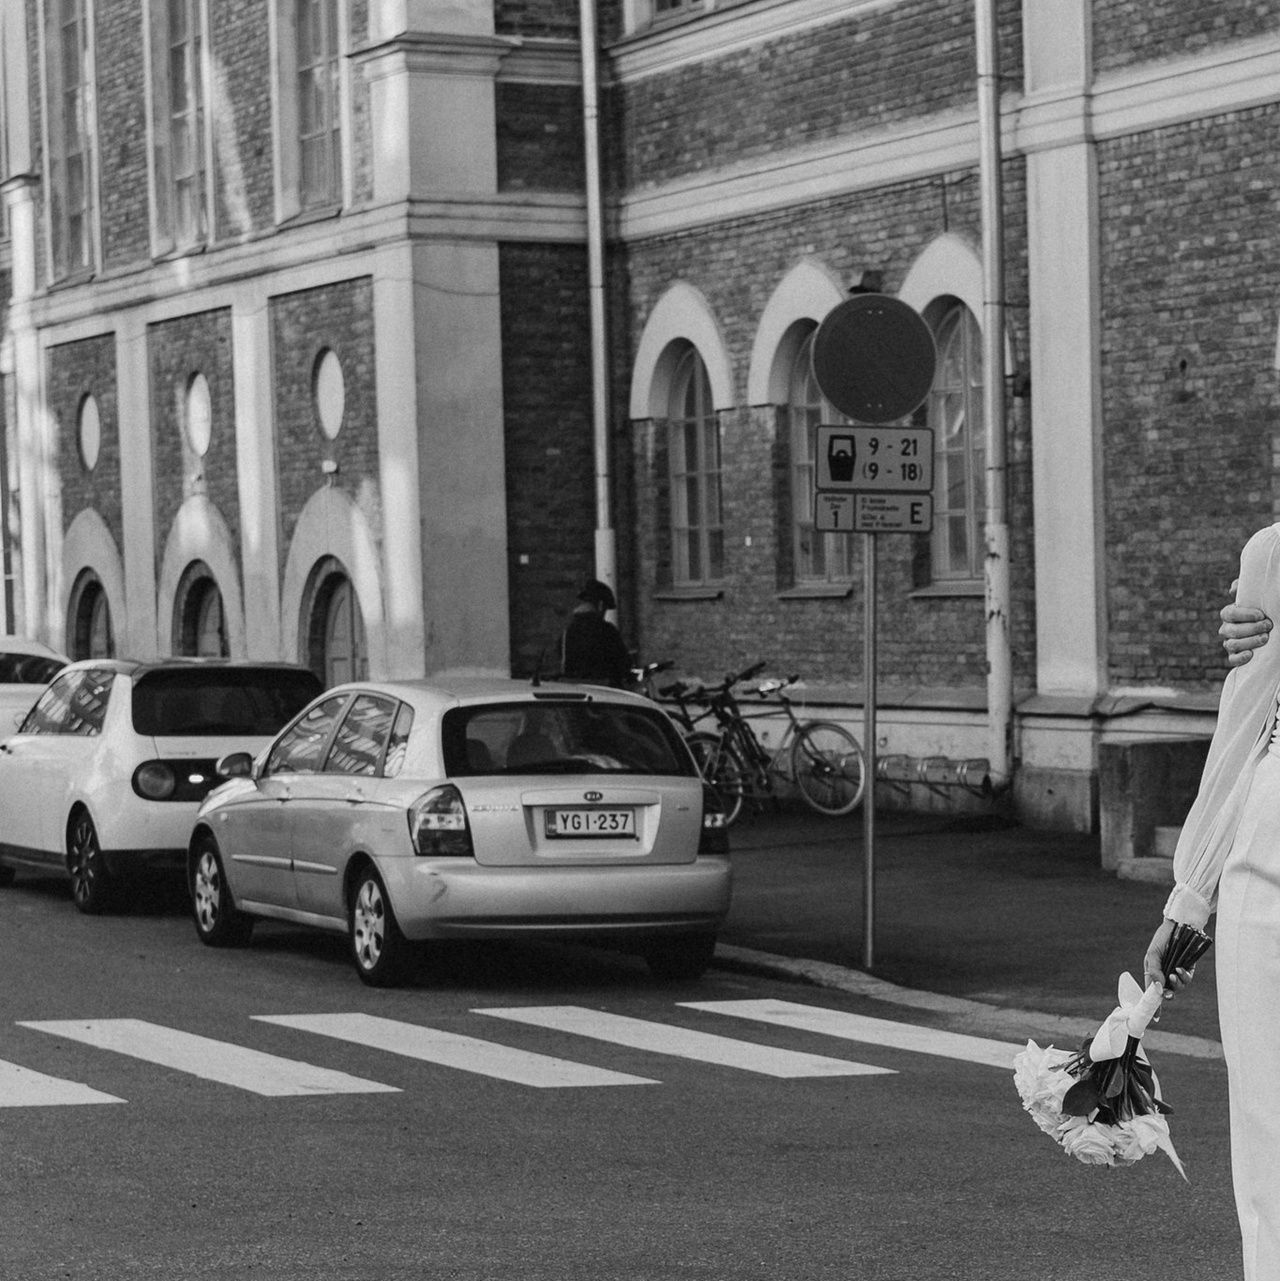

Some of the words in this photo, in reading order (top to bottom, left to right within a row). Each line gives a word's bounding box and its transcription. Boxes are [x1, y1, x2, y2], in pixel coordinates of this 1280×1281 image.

[900, 438, 918, 456] 21
[832, 510, 839, 528] 1
[910, 502, 923, 524] E
